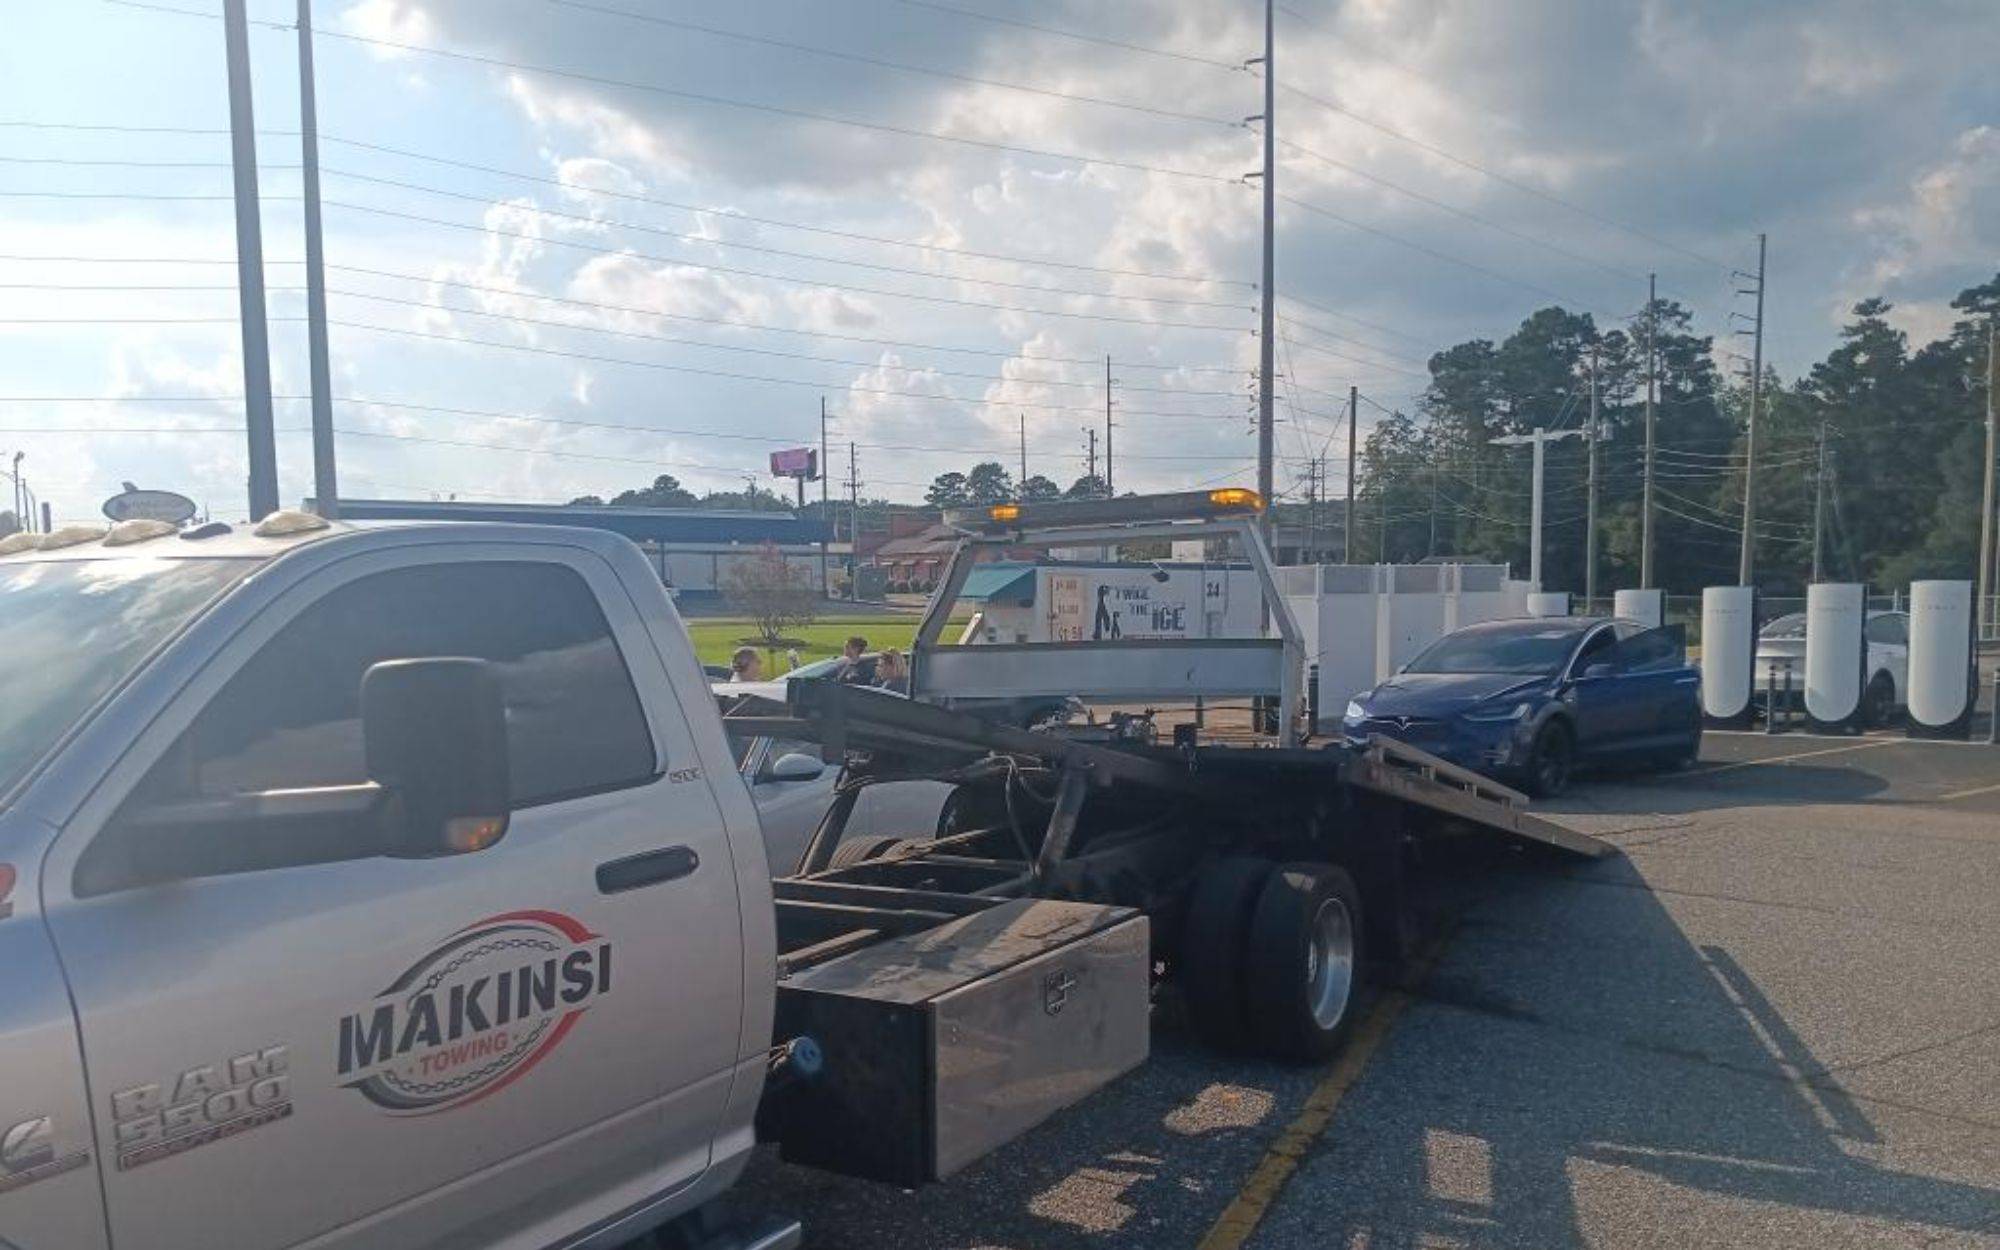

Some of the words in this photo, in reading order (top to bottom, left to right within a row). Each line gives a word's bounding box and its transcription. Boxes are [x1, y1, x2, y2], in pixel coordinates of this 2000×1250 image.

[1152, 606, 1187, 630] ICE
[337, 943, 613, 1075] MAKINSI
[111, 1043, 289, 1120] RAM
[419, 1031, 509, 1076] TOWING
